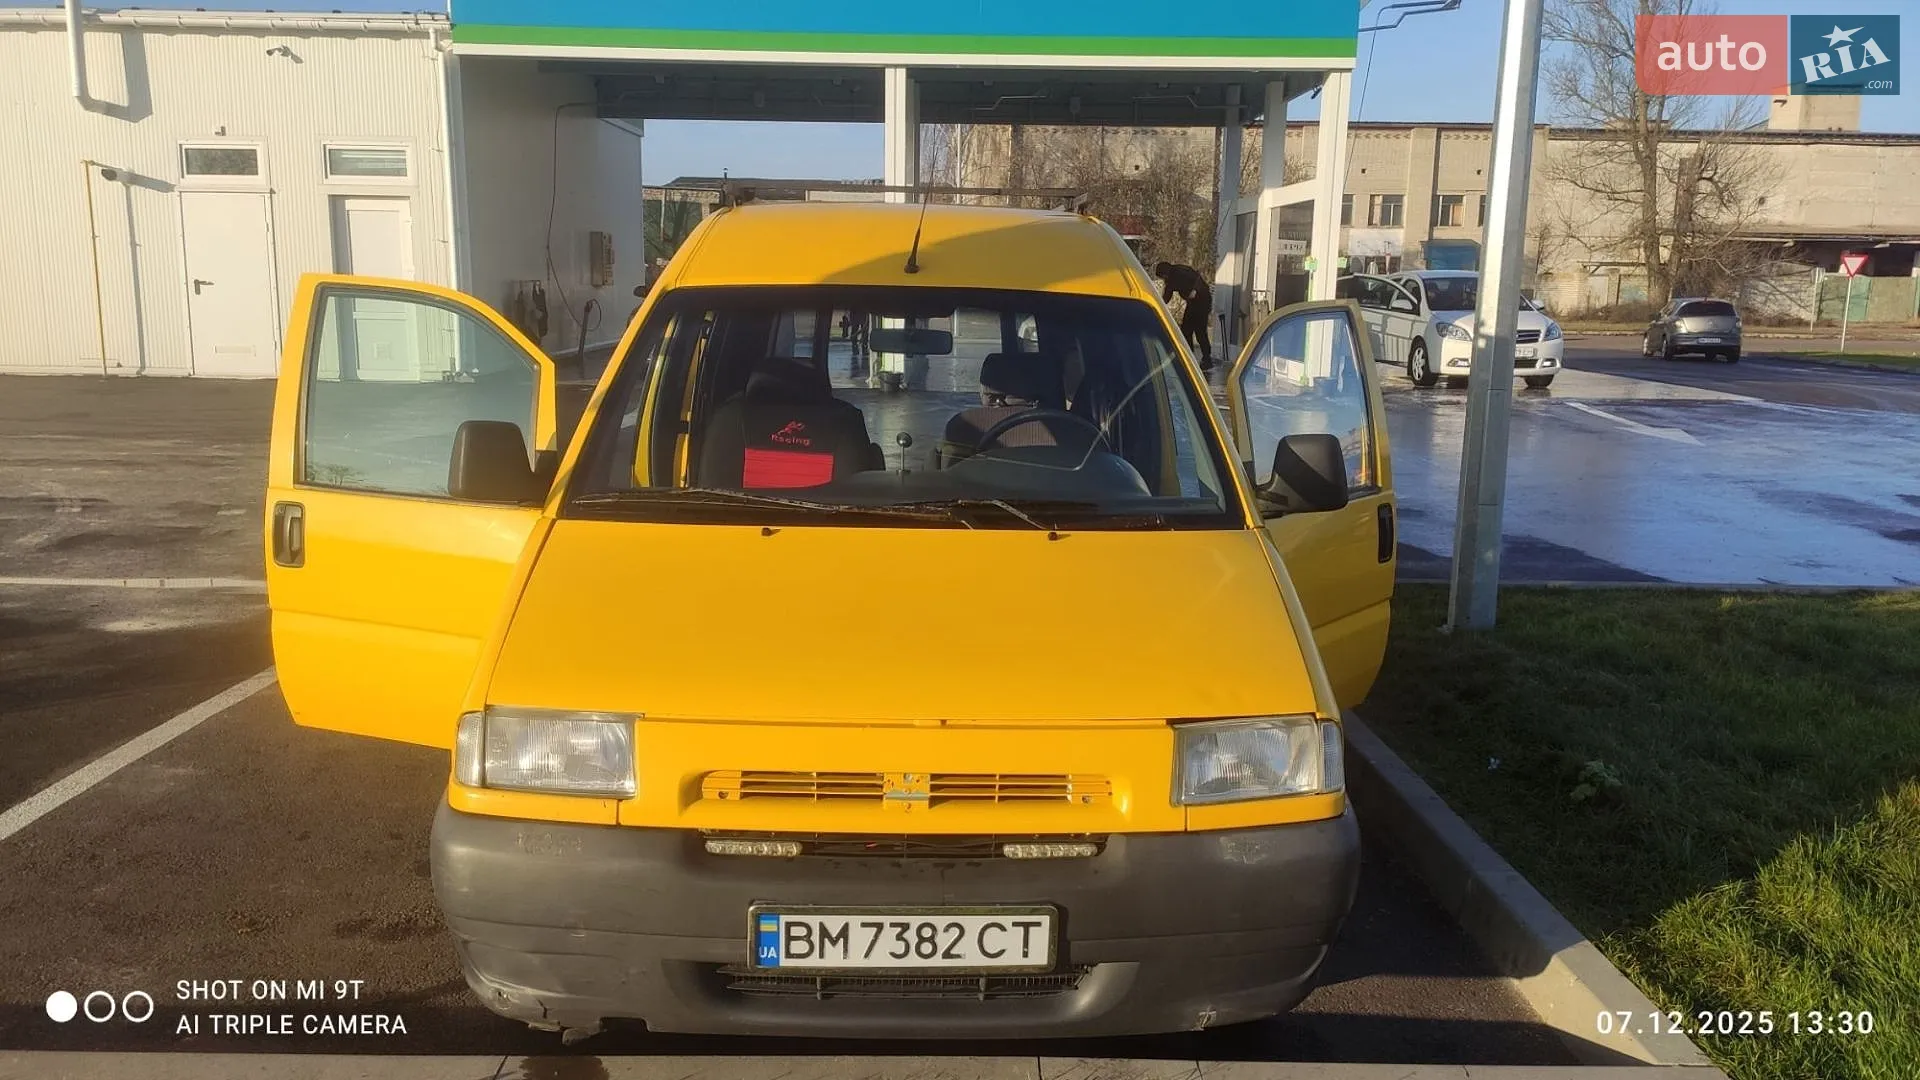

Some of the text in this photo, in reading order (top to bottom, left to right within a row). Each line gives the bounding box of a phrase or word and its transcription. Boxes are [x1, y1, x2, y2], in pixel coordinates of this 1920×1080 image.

[759, 946, 778, 959] UA
[784, 921, 1042, 960] BM 7382 CT
